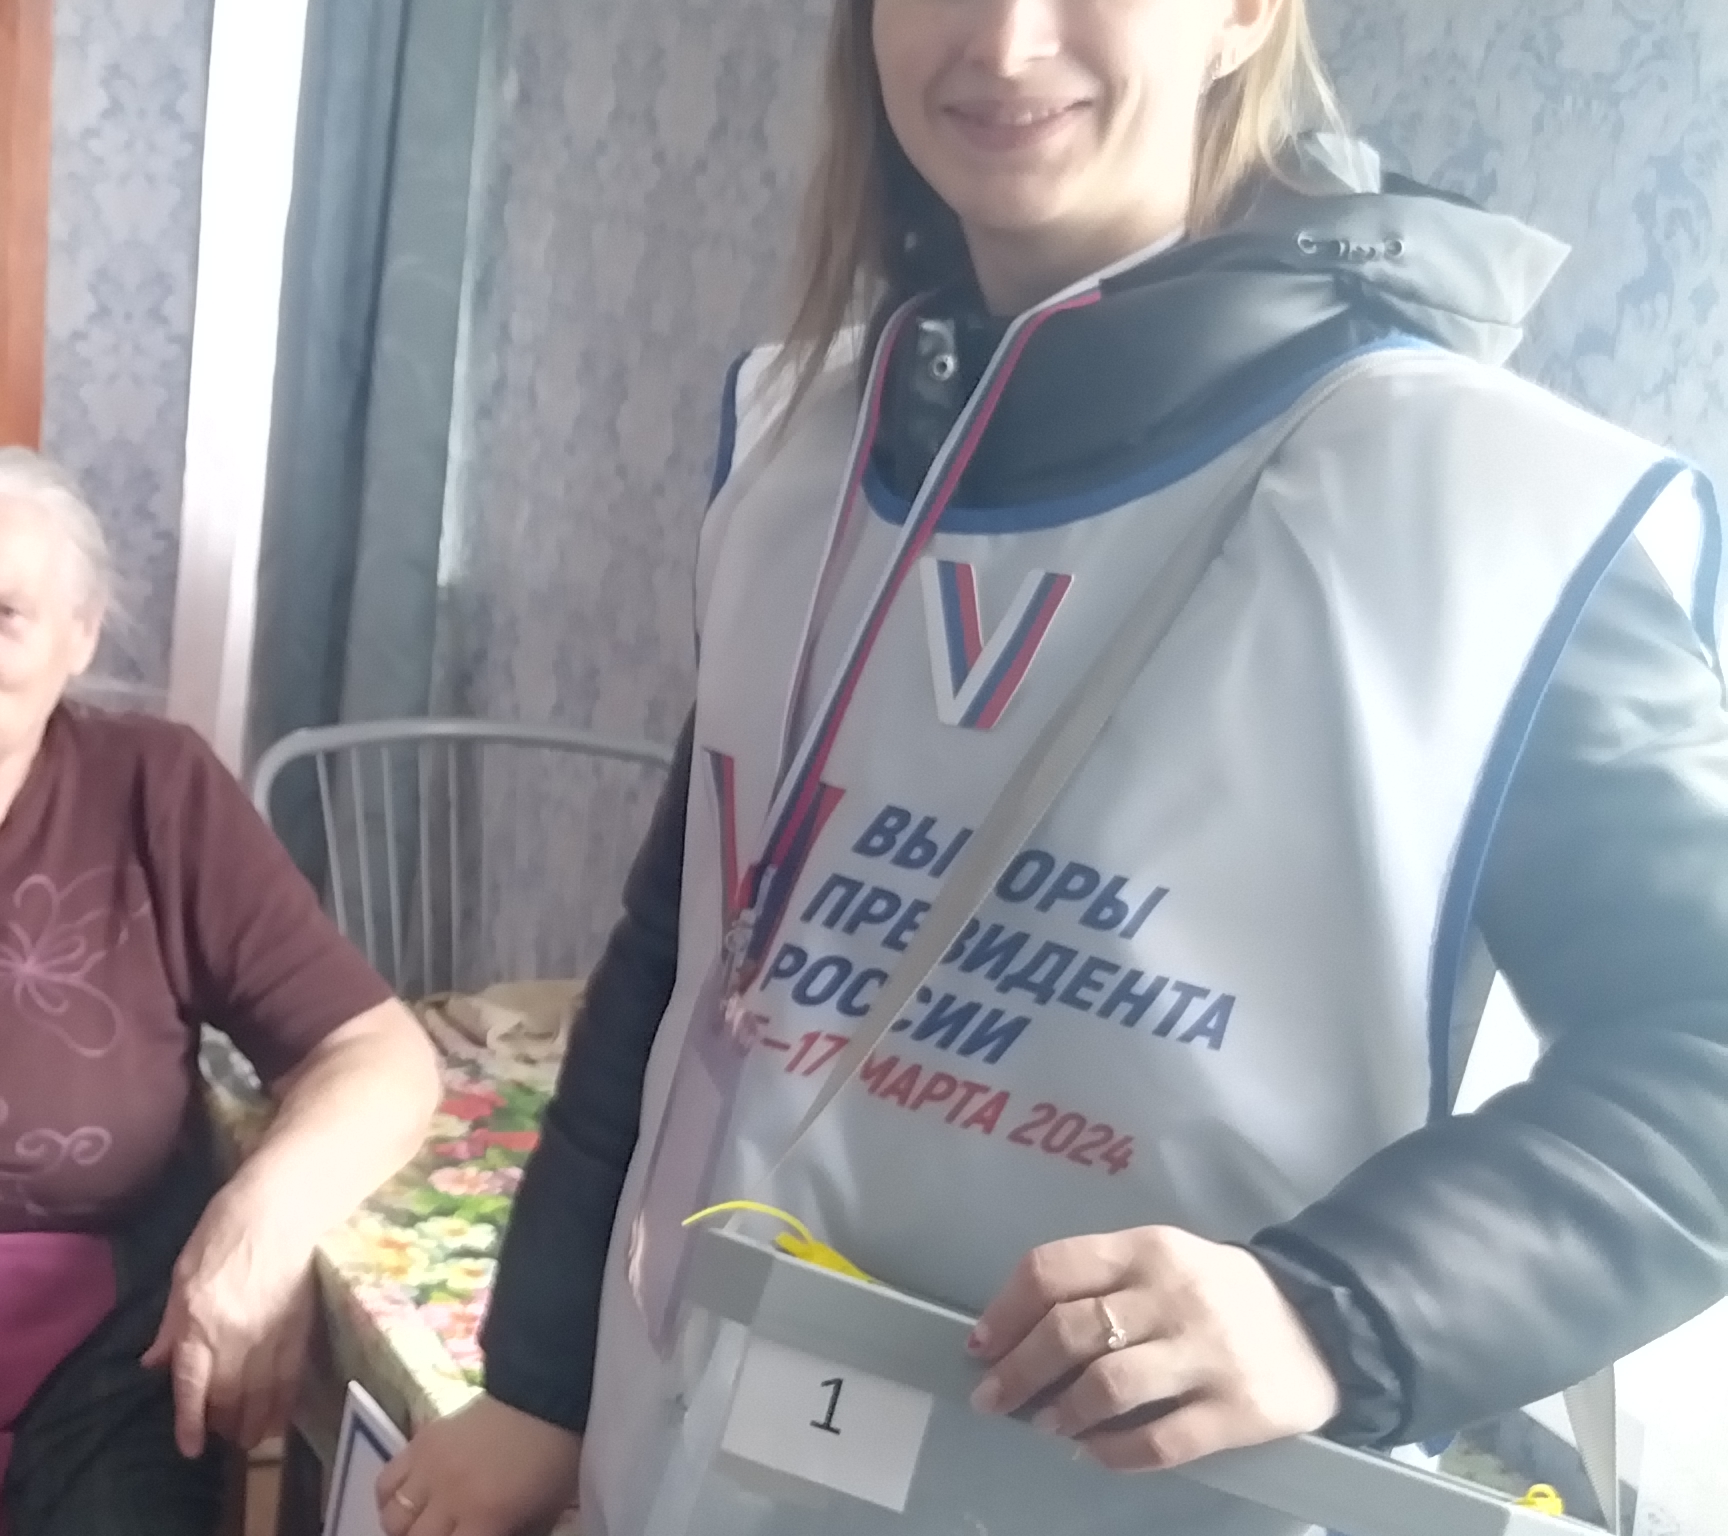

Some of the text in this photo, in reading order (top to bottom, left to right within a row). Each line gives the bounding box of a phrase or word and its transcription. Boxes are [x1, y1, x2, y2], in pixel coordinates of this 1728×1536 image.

[852, 804, 1170, 940] ВЫОРЫ
[1007, 1101, 1136, 1177] 2024
[809, 1377, 844, 1436] 1
